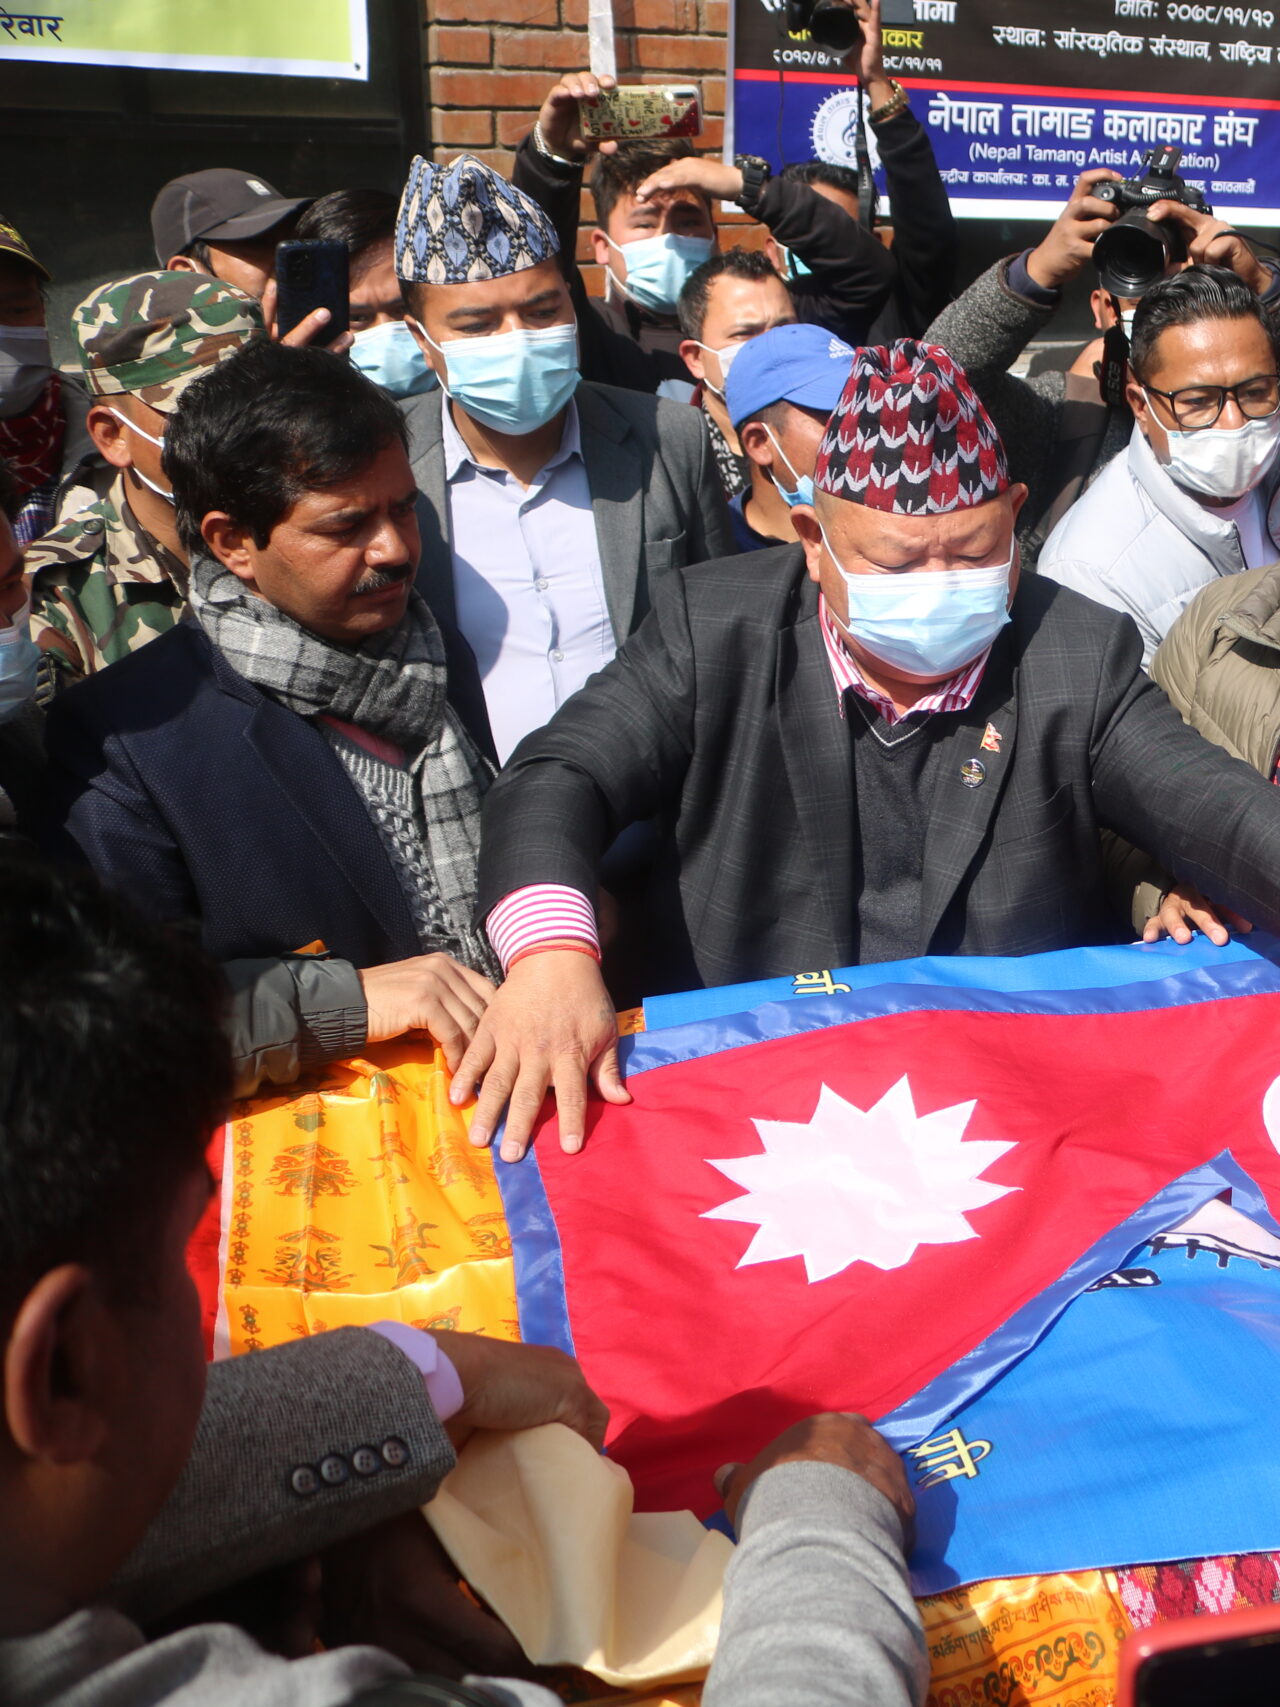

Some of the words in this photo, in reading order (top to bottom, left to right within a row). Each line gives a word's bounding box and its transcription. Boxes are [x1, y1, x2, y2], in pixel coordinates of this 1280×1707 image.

[992, 25, 1047, 48] स्थान:
[1053, 27, 1145, 58] सांस्कृतिक
[928, 92, 1004, 136] नेपाल
[1011, 104, 1096, 140] तामाङ
[1103, 109, 1207, 146] कलाकार
[1213, 110, 1259, 148] संघ
[969, 142, 1022, 163] (Nepal
[1025, 144, 1085, 167] Tamang
[1088, 148, 1127, 165] Artist
